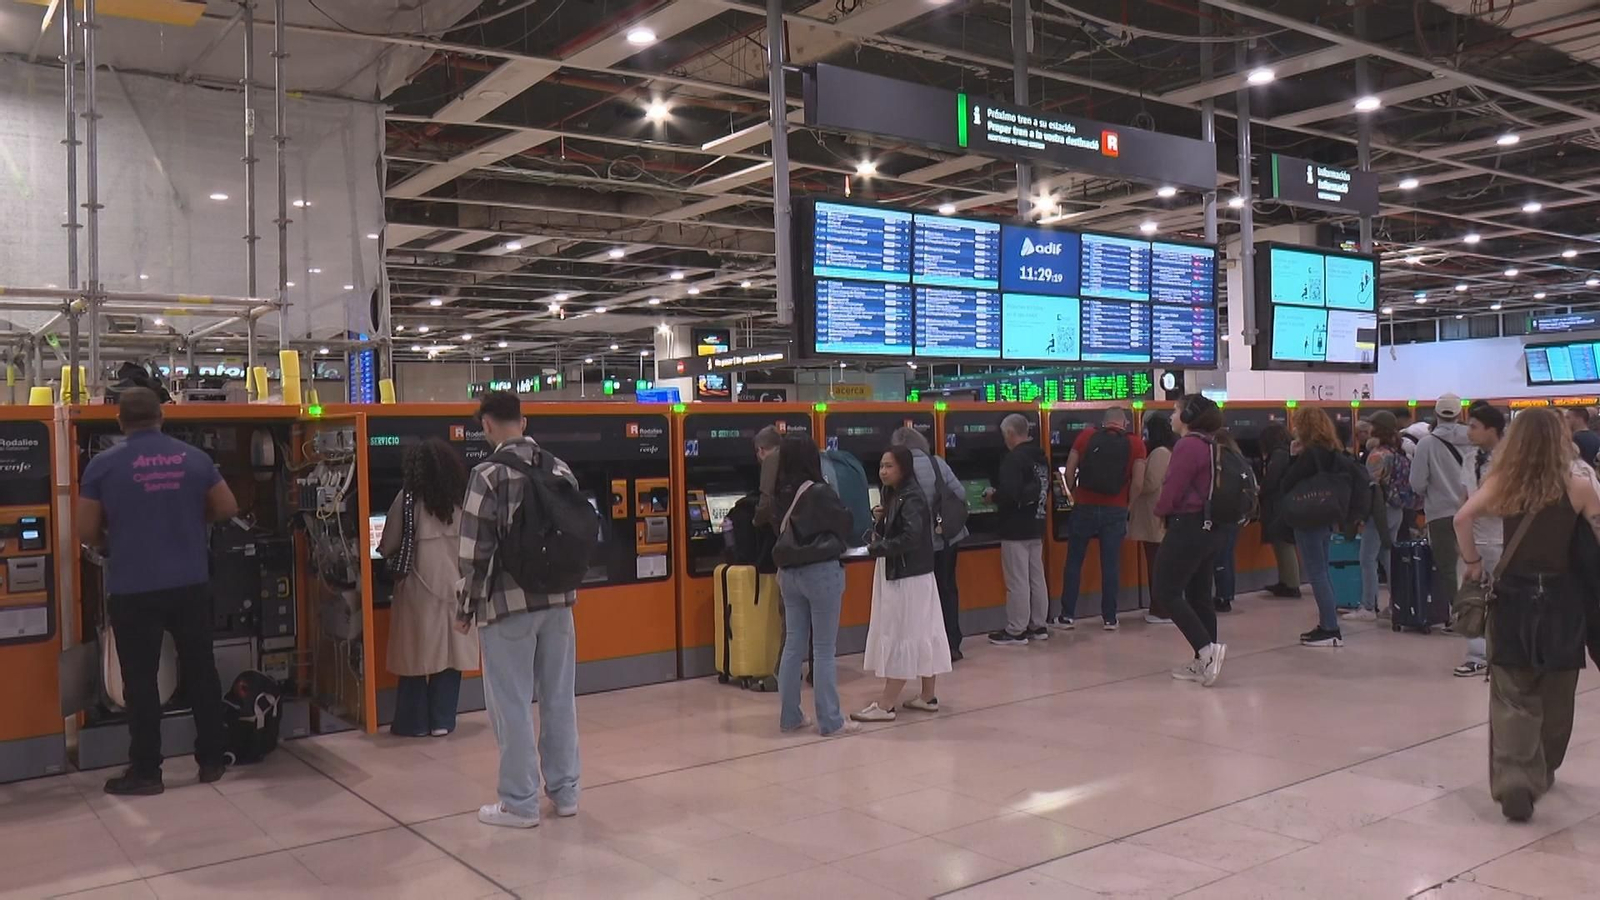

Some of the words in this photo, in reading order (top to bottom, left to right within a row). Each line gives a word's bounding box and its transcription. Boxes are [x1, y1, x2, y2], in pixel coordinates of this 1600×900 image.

[987, 108, 1017, 123] Próximo
[1017, 114, 1033, 126] tren
[1033, 119, 1039, 127] a
[1039, 119, 1048, 128] su
[1048, 119, 1077, 134] estación
[987, 120, 1012, 135] Proper
[1012, 125, 1029, 138] tren
[1029, 130, 1035, 139] a
[1035, 129, 1043, 140] la
[1043, 131, 1065, 144] vostra
[1065, 134, 1099, 151] destinació
[1107, 133, 1118, 151] R
[1035, 241, 1063, 256] adif
[455, 427, 464, 438] R
[630, 425, 639, 435] R
[370, 436, 400, 446] SERVICIO
[466, 450, 488, 459] renfe
[132, 454, 183, 469] Arrive
[133, 470, 186, 482] Customer
